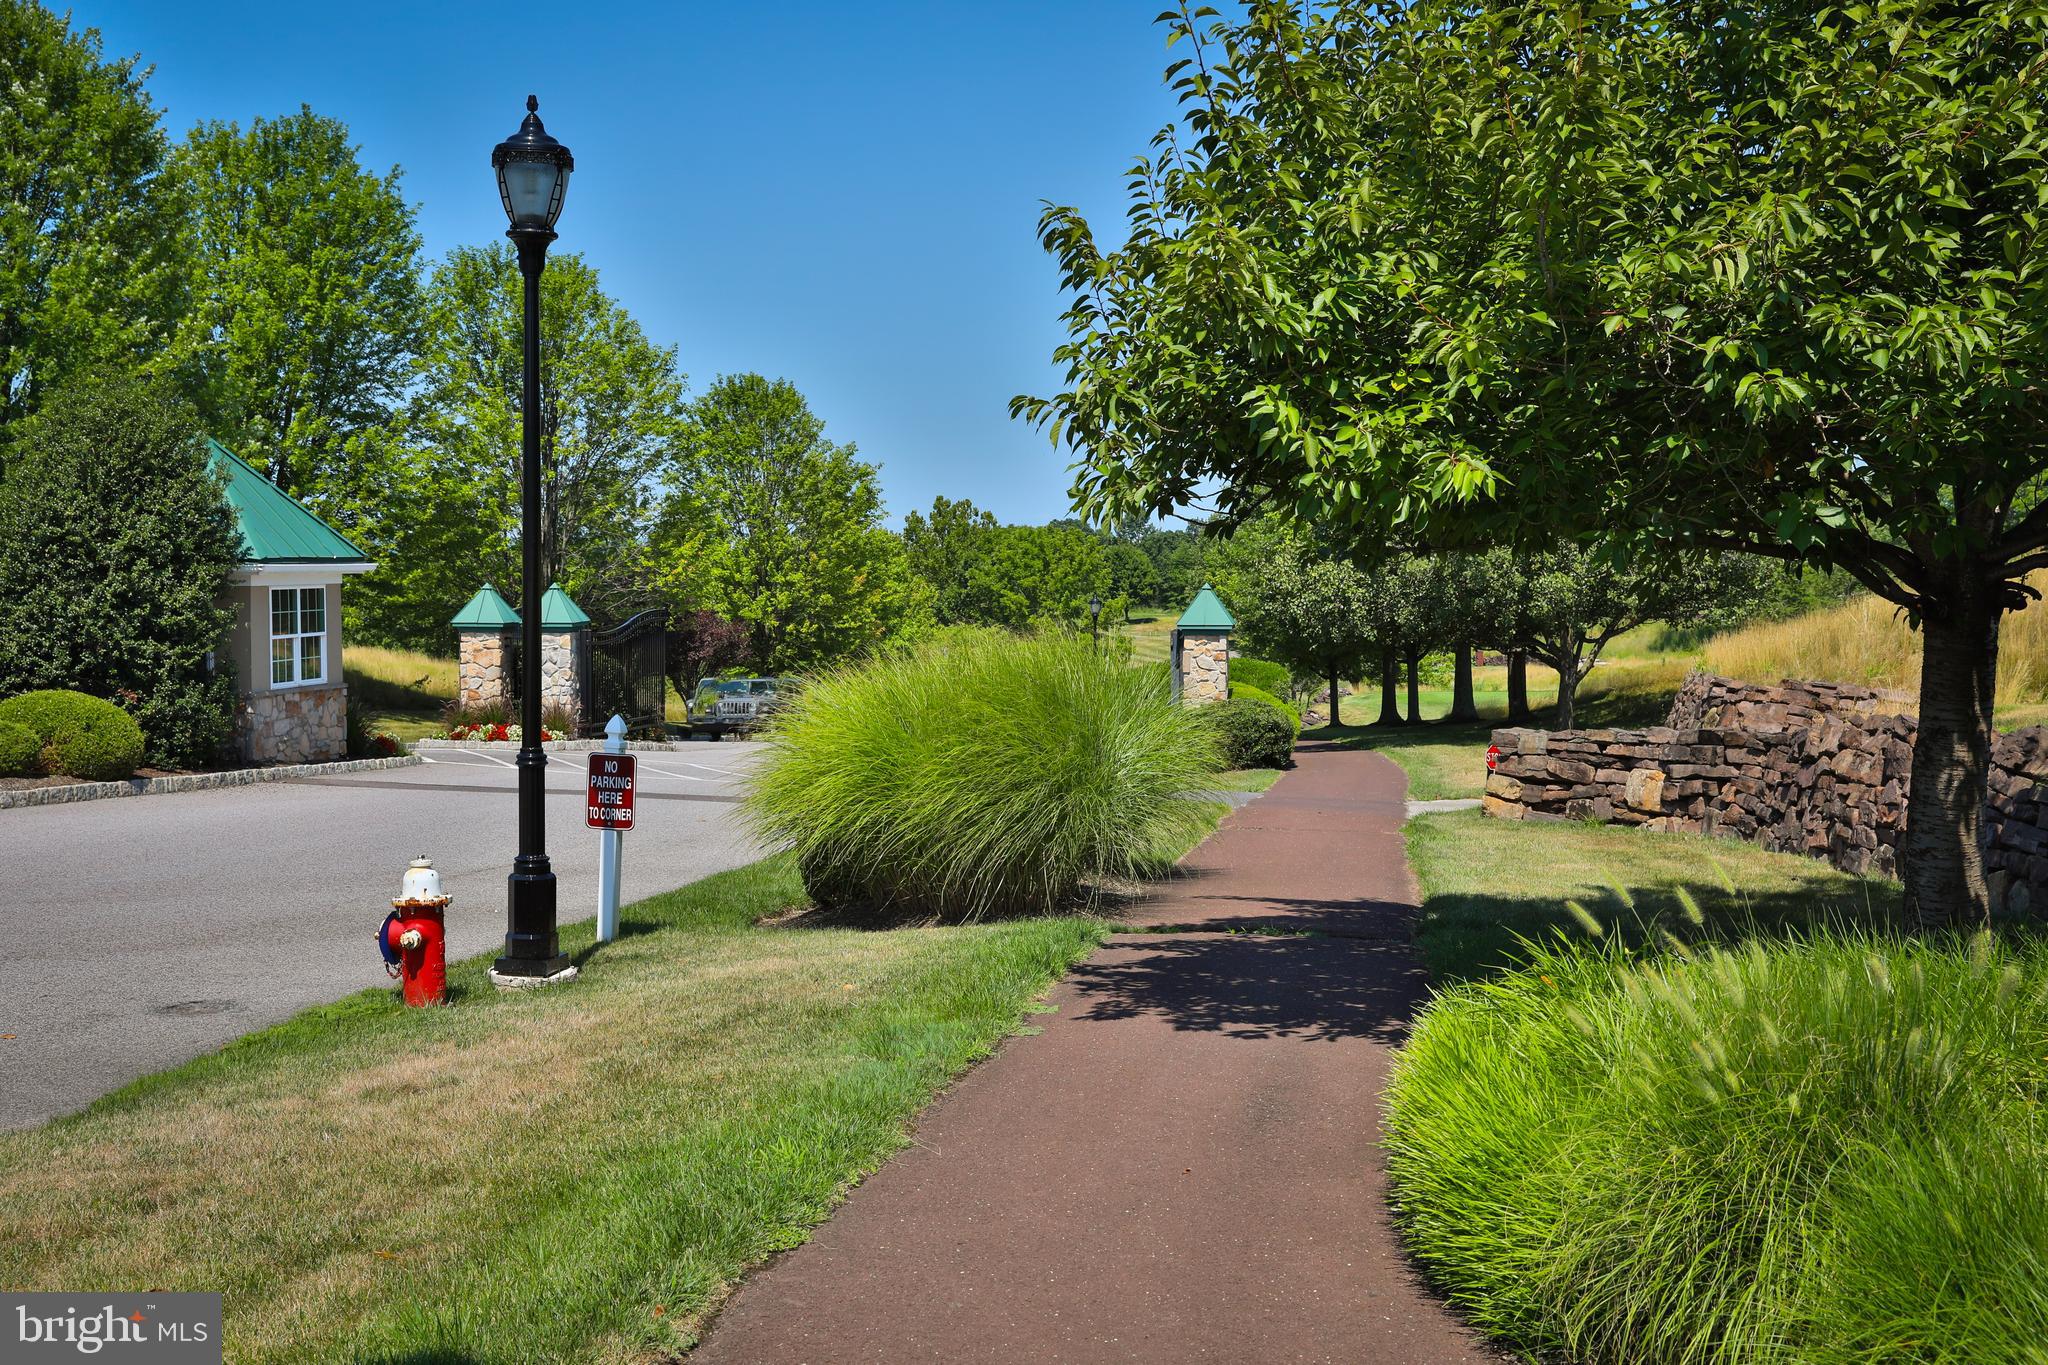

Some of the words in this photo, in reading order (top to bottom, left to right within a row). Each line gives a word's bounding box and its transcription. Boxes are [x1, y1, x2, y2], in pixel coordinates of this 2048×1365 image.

[604, 760, 618, 773] NO
[590, 775, 632, 789] PARKING
[598, 791, 623, 804] HERE
[588, 807, 599, 819] TO
[600, 808, 632, 821] CORNER
